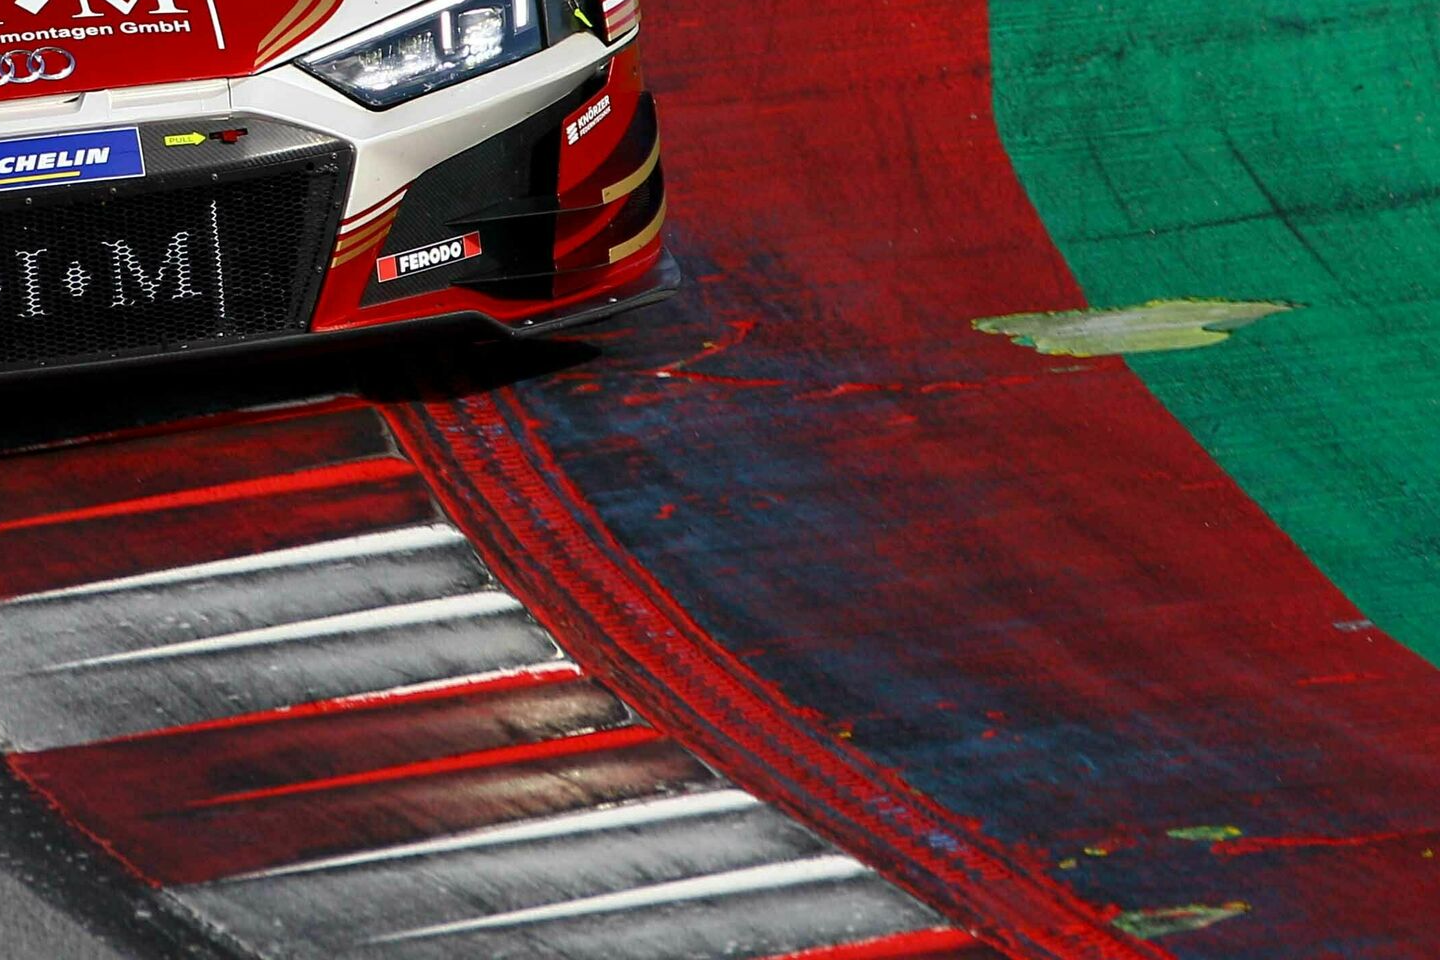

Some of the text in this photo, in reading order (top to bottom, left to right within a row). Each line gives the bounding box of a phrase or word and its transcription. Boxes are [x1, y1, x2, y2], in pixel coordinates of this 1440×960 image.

[119, 19, 192, 36] GmbH
[168, 136, 194, 144] PULL
[399, 241, 462, 273] FERODO
